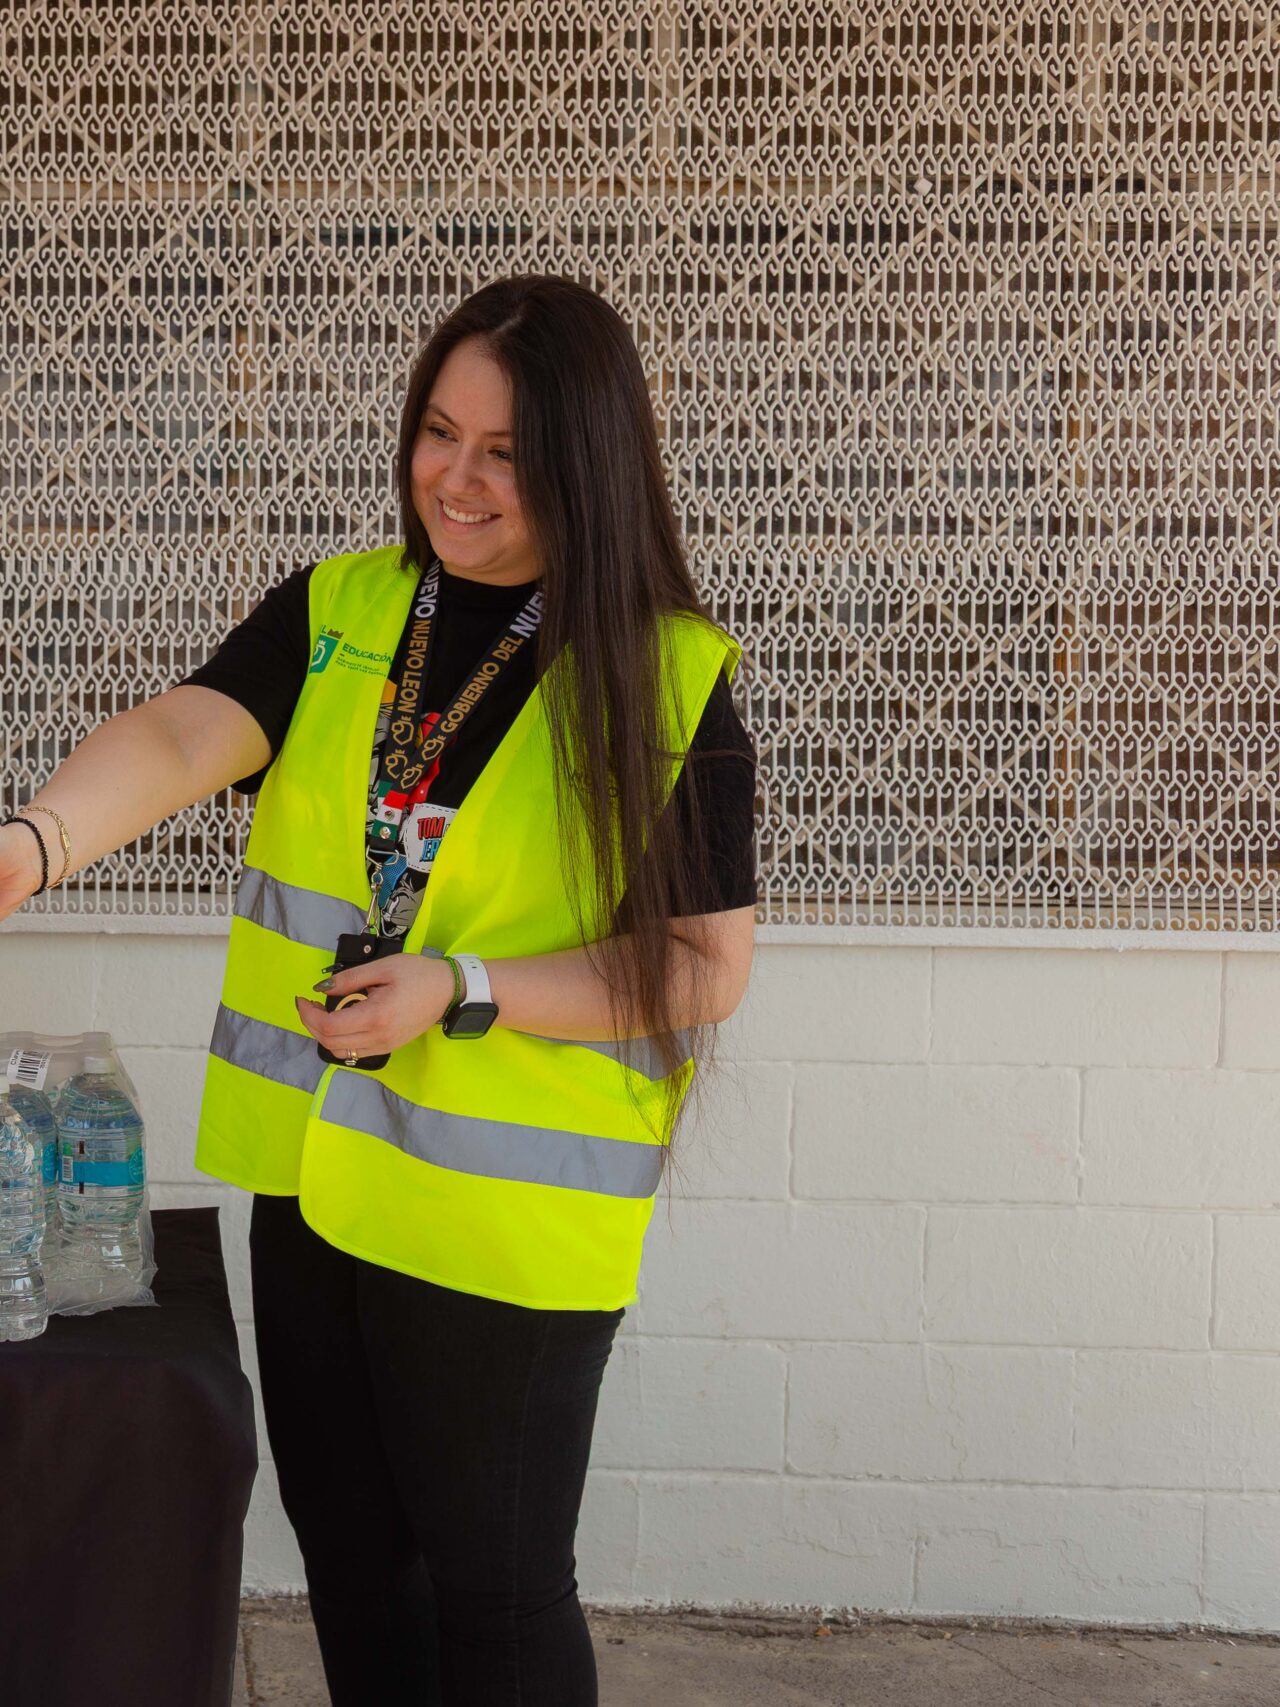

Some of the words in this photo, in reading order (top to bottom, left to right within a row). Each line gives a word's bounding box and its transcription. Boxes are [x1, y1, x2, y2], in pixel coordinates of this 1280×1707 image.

[414, 558, 440, 618] NUEVO
[406, 620, 432, 670] NUEVO
[440, 662, 500, 733] GOBIERNO
[492, 636, 524, 662] DEL
[509, 591, 545, 639] NUE
[397, 670, 422, 714] LEON
[417, 816, 446, 840] TOM
